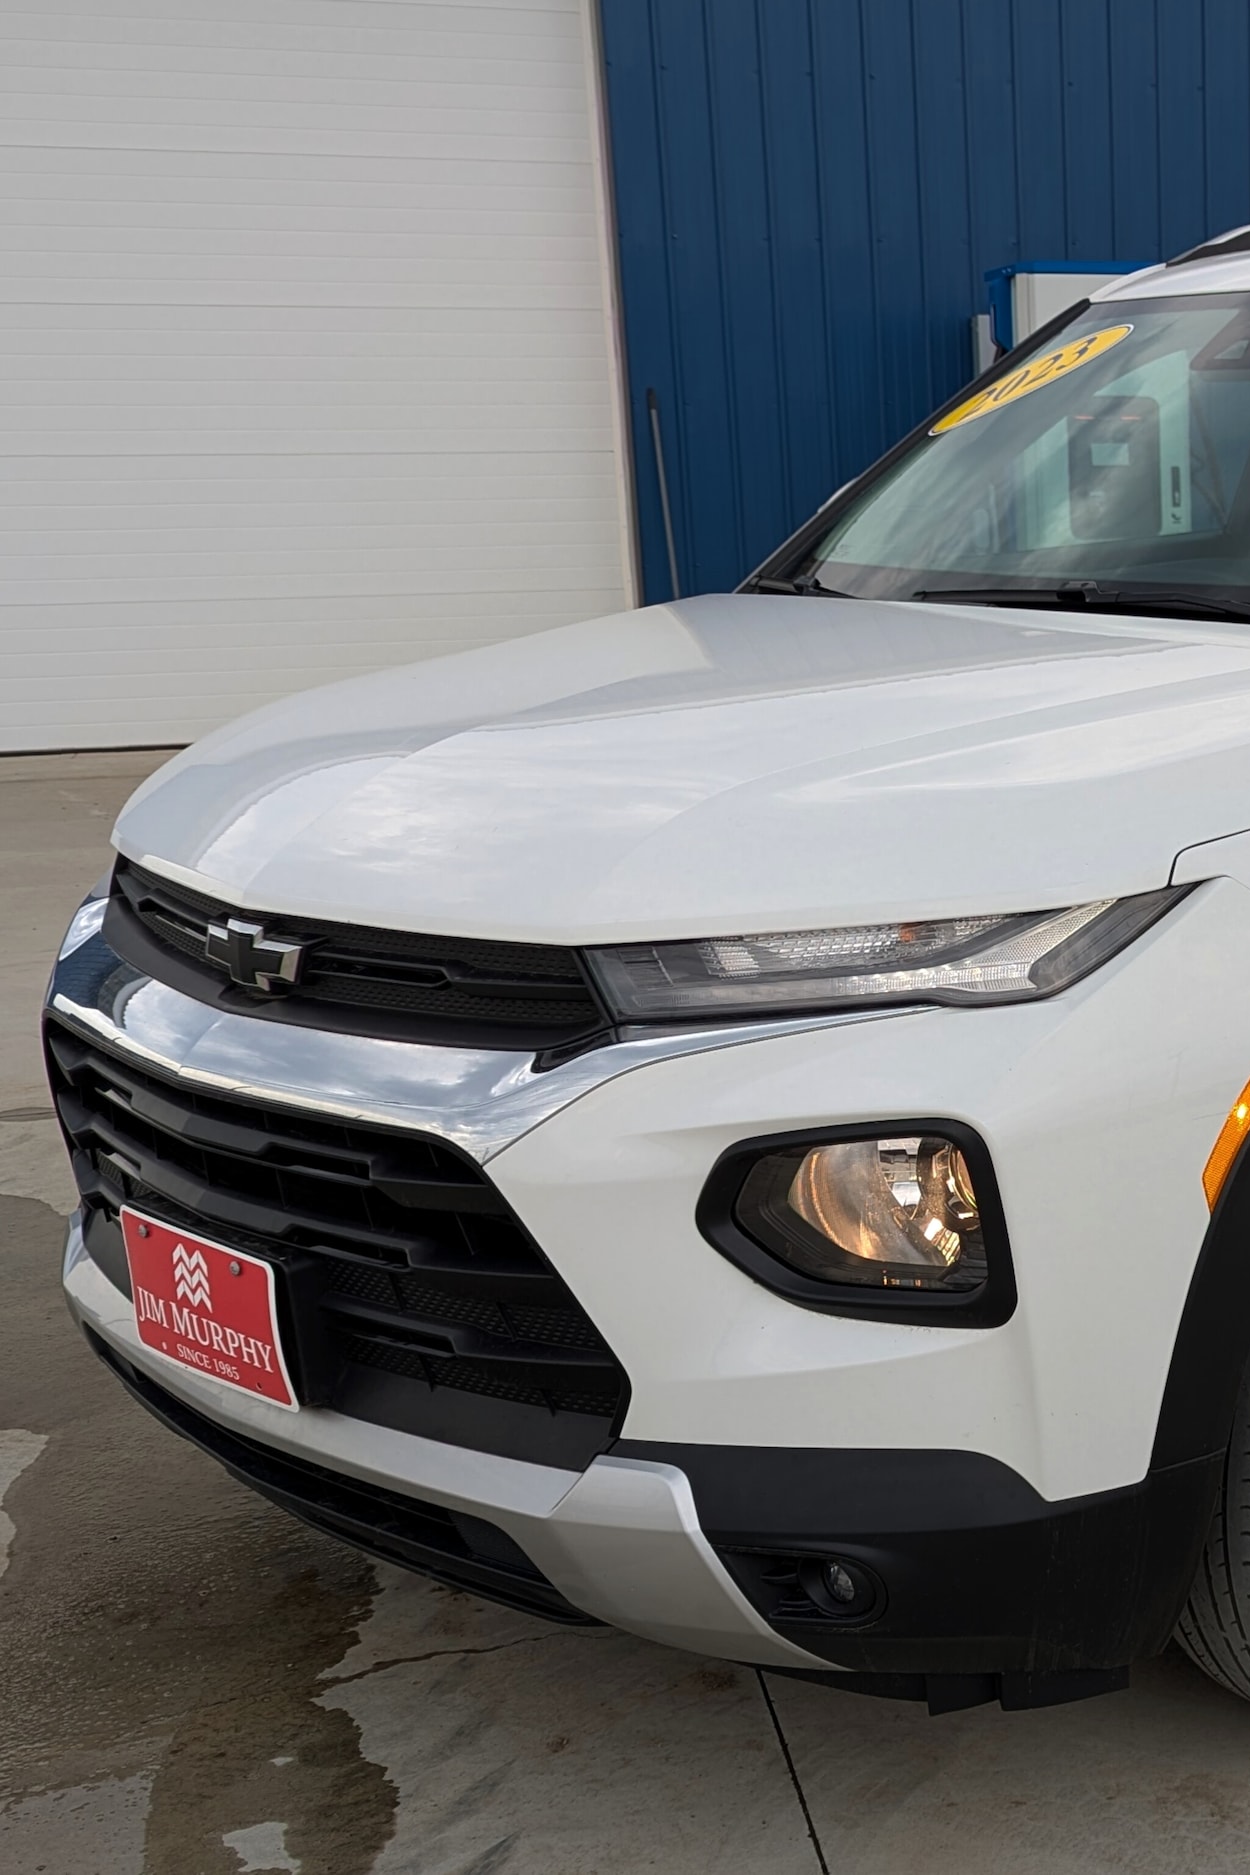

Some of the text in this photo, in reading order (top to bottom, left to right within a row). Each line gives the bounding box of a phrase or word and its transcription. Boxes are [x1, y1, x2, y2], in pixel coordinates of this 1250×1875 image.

[958, 336, 1098, 423] 2023
[136, 1286, 274, 1373] JIM MURPHY
[177, 1343, 240, 1380] SINCE 1985
